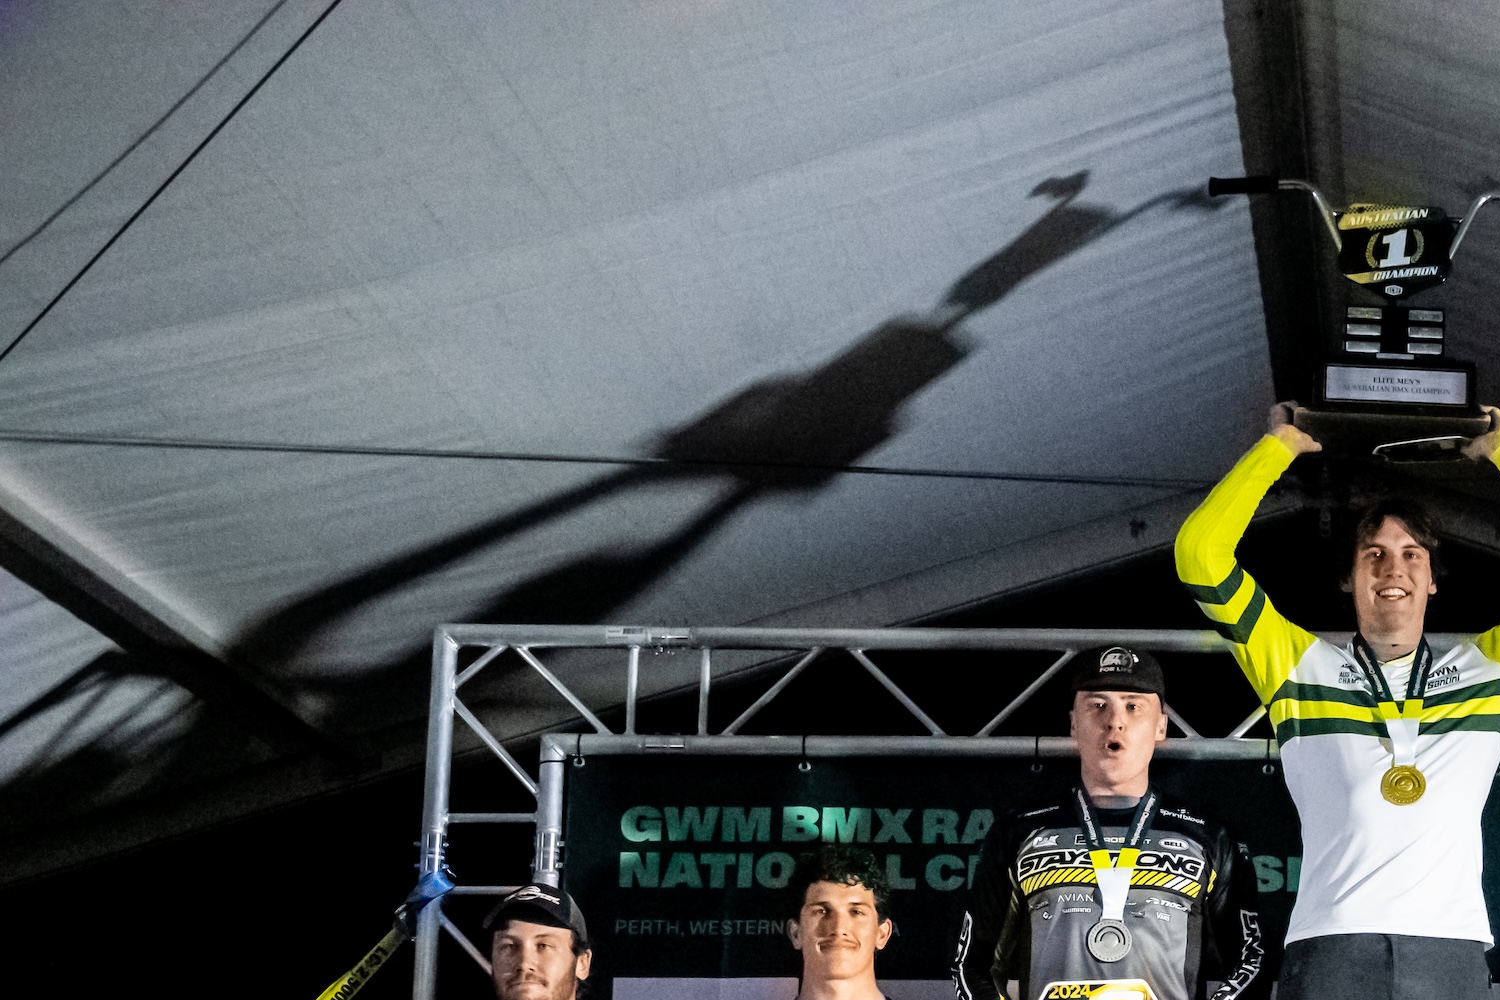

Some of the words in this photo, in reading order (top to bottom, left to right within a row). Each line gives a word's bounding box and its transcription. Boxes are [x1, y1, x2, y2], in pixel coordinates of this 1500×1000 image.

[1346, 208, 1429, 227] AUSTRALIAN
[1379, 229, 1411, 268] 1
[1373, 266, 1438, 281] CHAMPION
[1372, 376, 1394, 384] ELITE
[1397, 377, 1421, 386] MEN'S
[1343, 384, 1390, 393] AUSTRALIAN
[1392, 385, 1409, 394] BMX
[1410, 387, 1451, 395] CHAMPION
[620, 805, 772, 843] GWM
[782, 806, 914, 844] BMX
[1163, 841, 1186, 849] BELL
[618, 851, 917, 891] NATIOL
[1057, 893, 1093, 903] AVIAN
[1160, 899, 1189, 913] TIOGA
[615, 919, 684, 937] PERTH,
[689, 919, 785, 937] WESTERN
[1048, 984, 1090, 999] 2024
